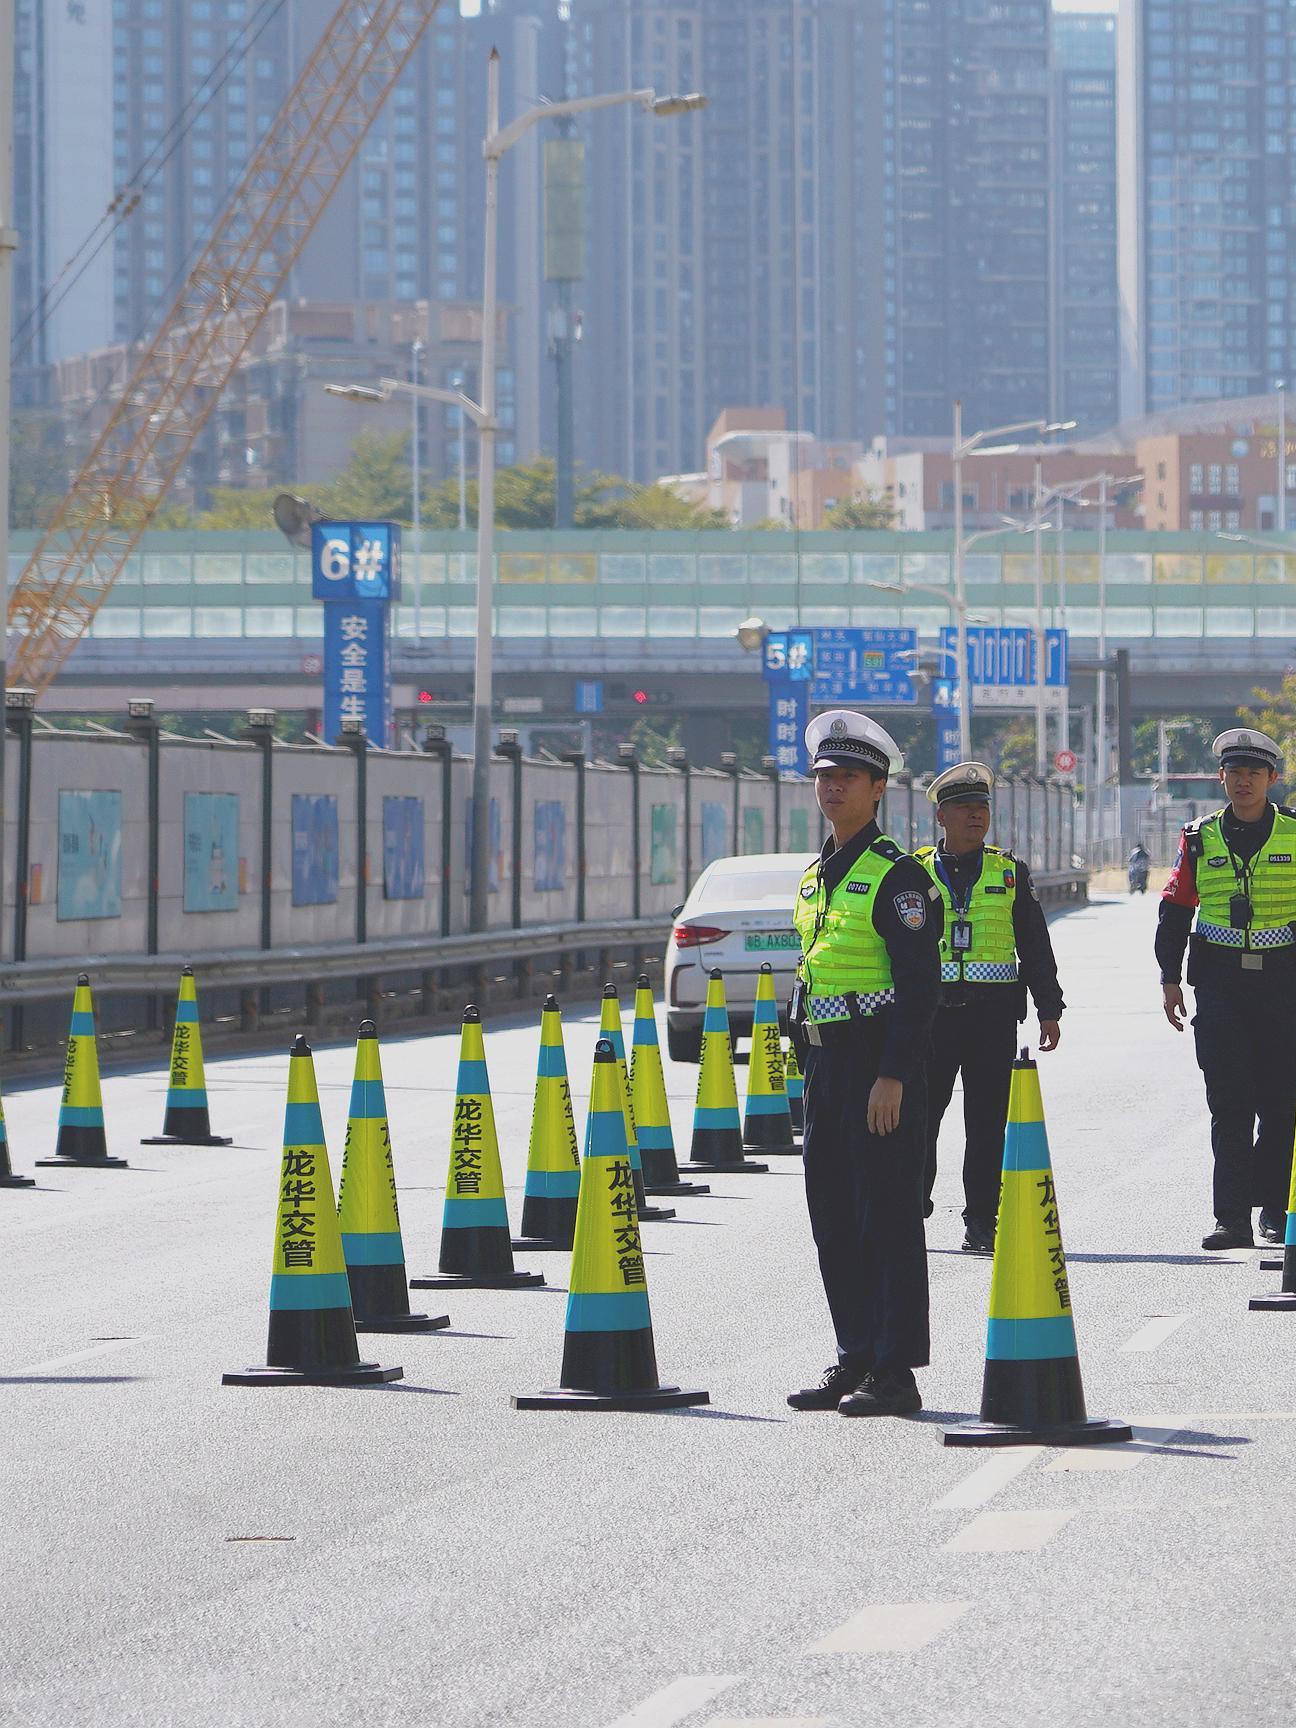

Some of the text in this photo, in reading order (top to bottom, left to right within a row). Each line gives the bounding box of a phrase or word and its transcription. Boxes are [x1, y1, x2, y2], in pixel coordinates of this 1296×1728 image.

[321, 539, 384, 581] 6#
[171, 1024, 191, 1087] 龙华交管
[762, 1024, 786, 1092] 龙华交管
[454, 1097, 484, 1196] 龙华交管
[282, 1148, 317, 1269] 龙华交管
[605, 1159, 648, 1289] 龙华交管
